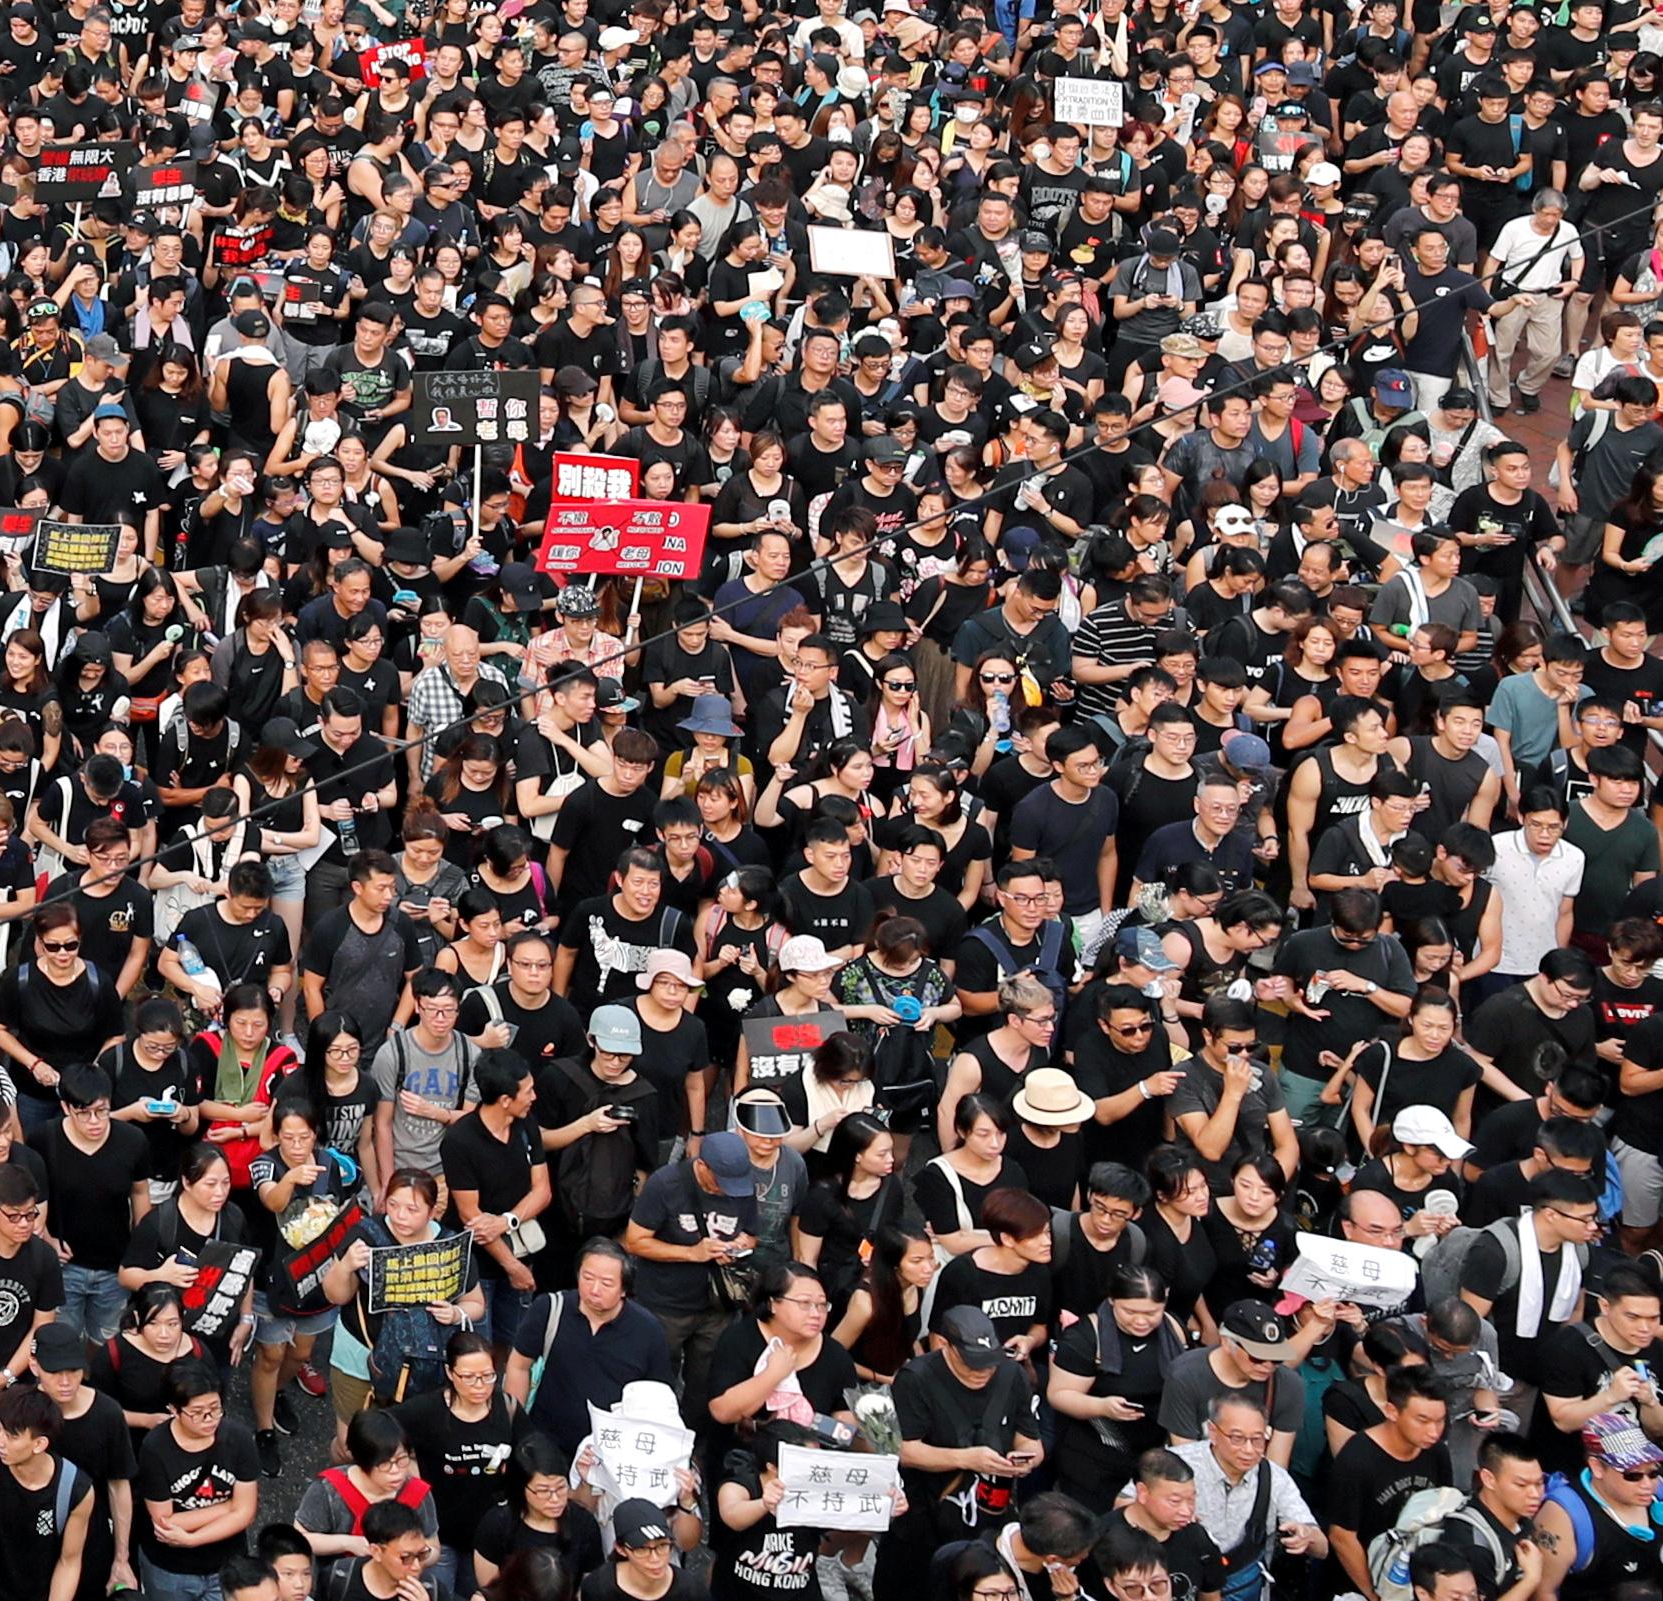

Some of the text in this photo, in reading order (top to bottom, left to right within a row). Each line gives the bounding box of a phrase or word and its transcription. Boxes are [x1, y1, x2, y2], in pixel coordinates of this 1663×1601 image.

[376, 41, 413, 61] STOP
[1055, 94, 1109, 107] EXTRADITION
[135, 183, 196, 206] 沒有暴動
[1030, 186, 1080, 206] ROOTS
[475, 419, 530, 442] 老母
[557, 462, 634, 501] 別殺我
[620, 547, 651, 561] 老母
[663, 536, 688, 552] INA
[658, 560, 685, 576] ION
[749, 1053, 807, 1080] 沒有
[404, 1068, 461, 1098] GAP
[1329, 1253, 1382, 1283] 慈母
[984, 1296, 1036, 1319] ADMIT
[597, 1428, 657, 1457] 慈母
[616, 1462, 670, 1491] 持武
[807, 1464, 869, 1488] 慈母
[785, 1489, 882, 1515] 不持武
[733, 1563, 811, 1592] HONG KONG
